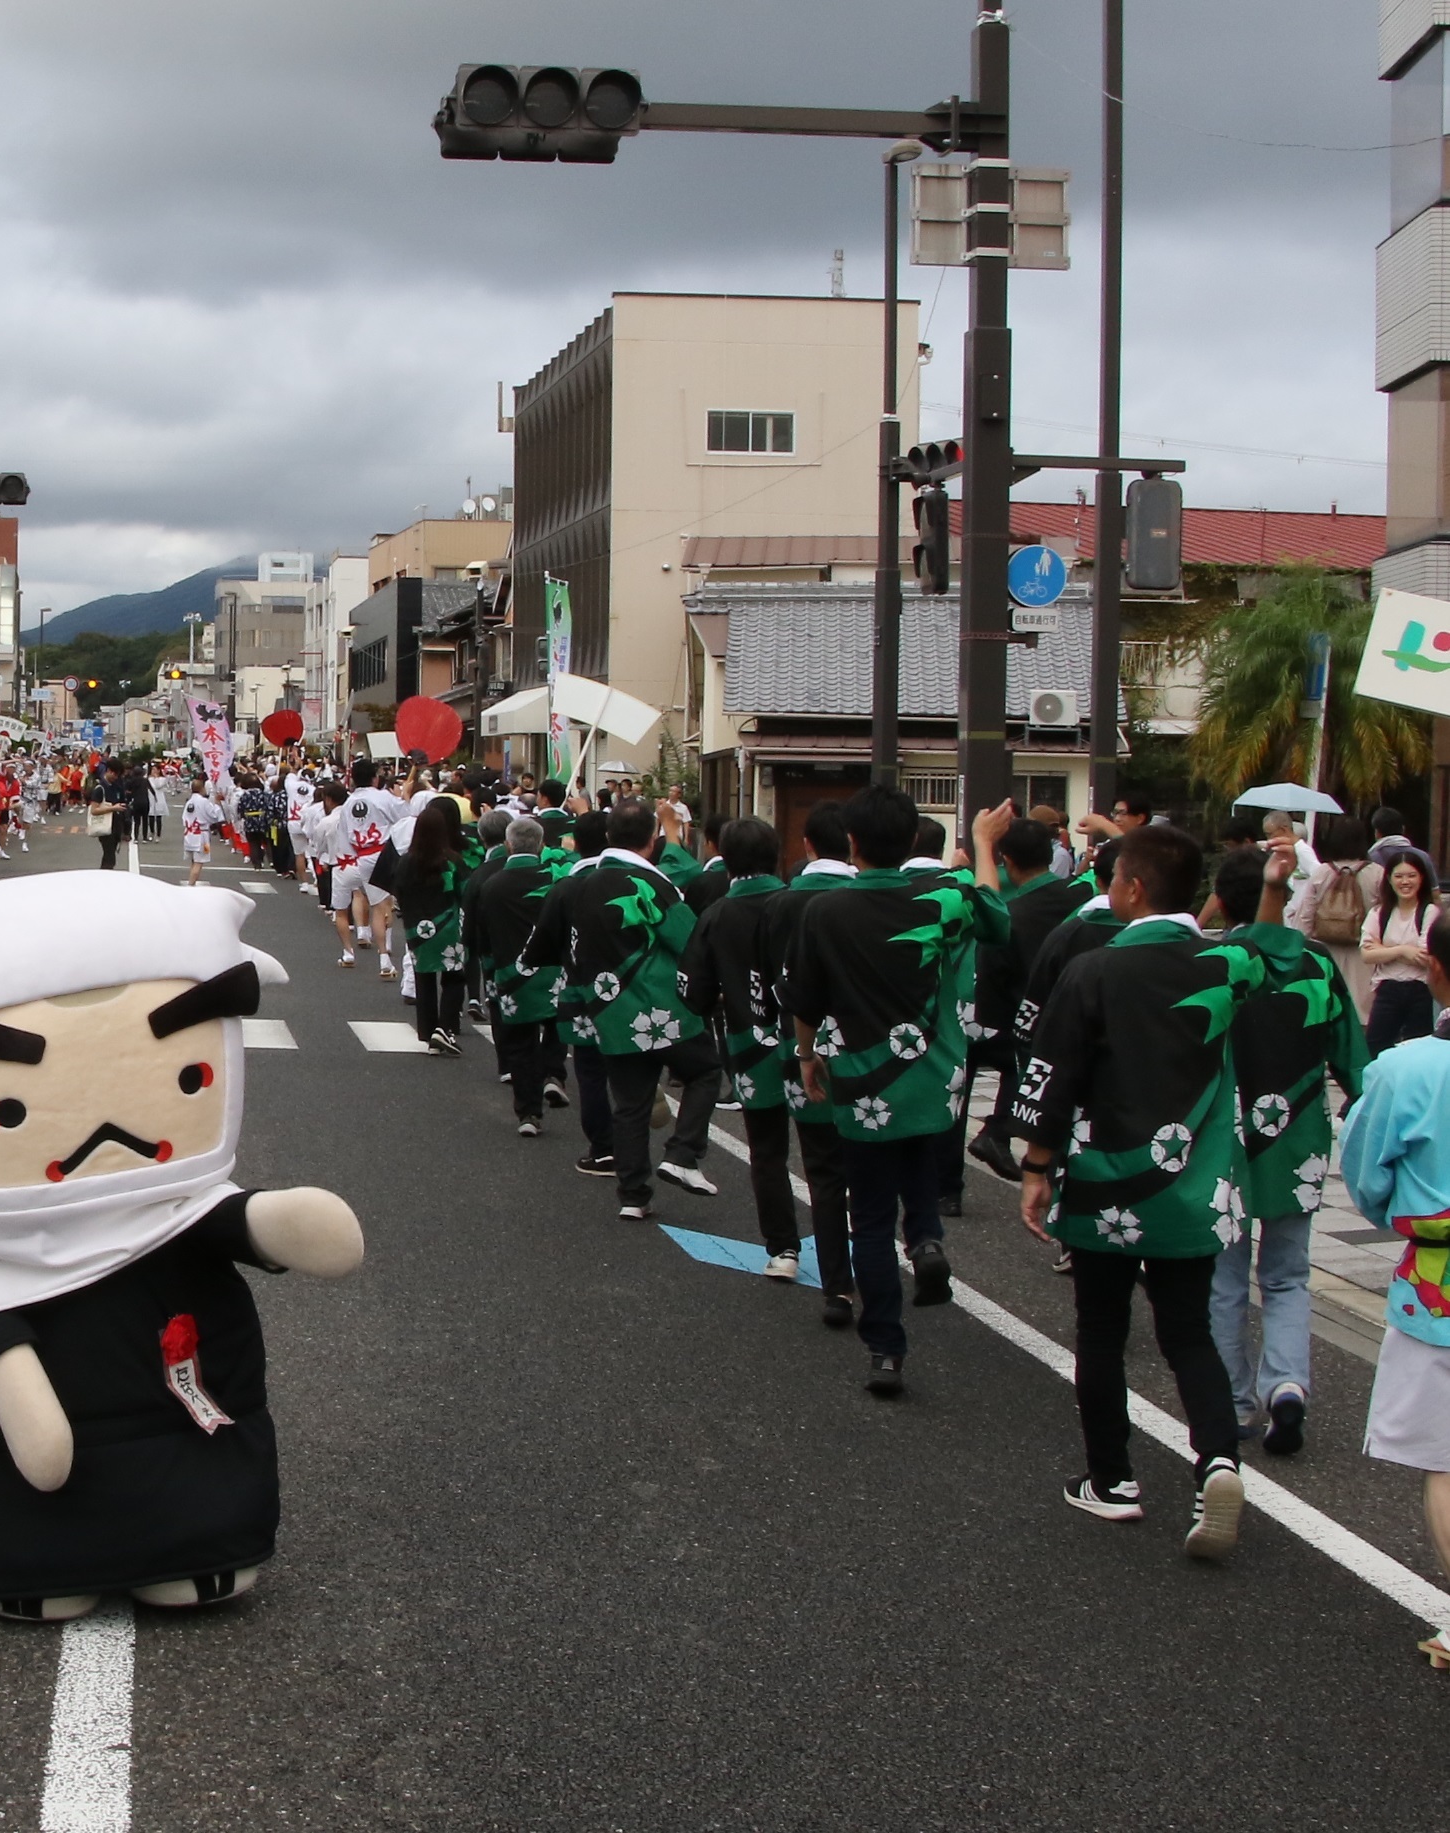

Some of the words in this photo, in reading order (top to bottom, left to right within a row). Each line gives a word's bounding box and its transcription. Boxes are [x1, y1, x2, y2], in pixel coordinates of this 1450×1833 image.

[1015, 615, 1056, 625] 自転車通行可
